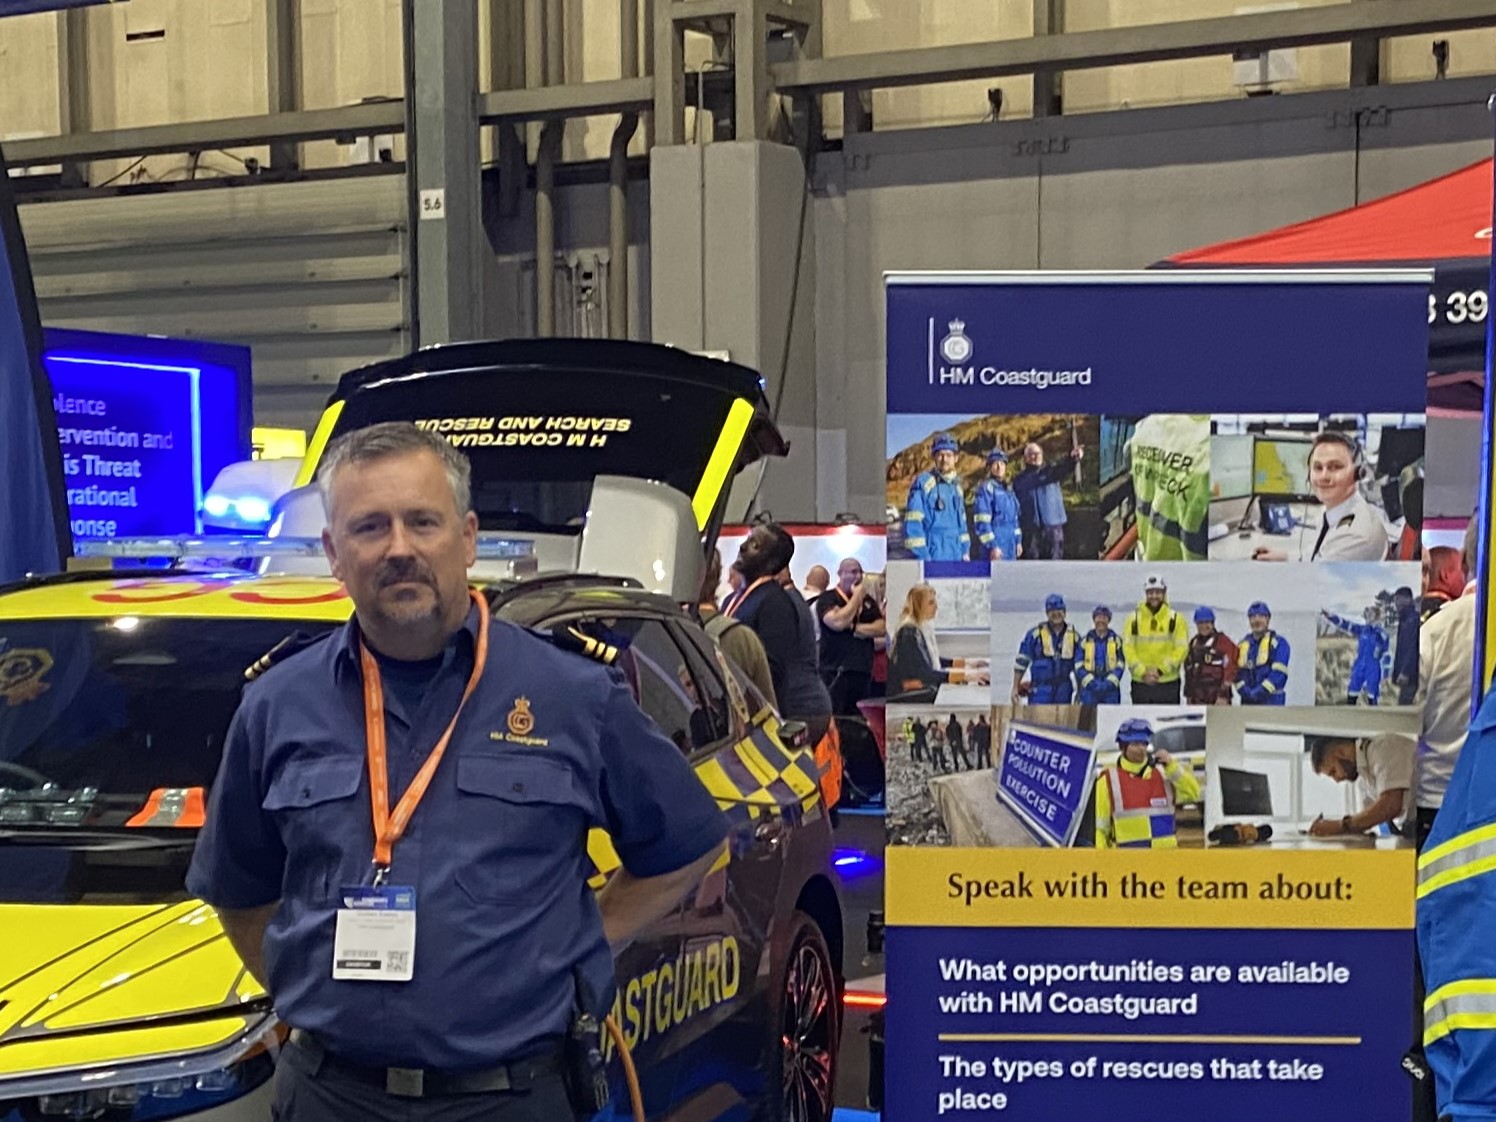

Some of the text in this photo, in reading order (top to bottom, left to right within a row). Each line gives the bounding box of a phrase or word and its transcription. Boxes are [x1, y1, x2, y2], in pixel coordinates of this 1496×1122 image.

[424, 197, 442, 211] 5.6
[939, 367, 1092, 389] HM Coastguard
[498, 417, 543, 430] AND
[546, 417, 632, 431] SEARCH
[58, 426, 173, 449] ervention and
[567, 433, 586, 446] M
[590, 434, 607, 447] H
[64, 453, 142, 478] is Threat
[67, 484, 138, 507] rational
[1013, 738, 1071, 774] COUNTER
[1008, 753, 1072, 799] POLLUTION
[1005, 774, 1058, 821] EXERCISE
[948, 870, 1352, 905] Speak with the team about:
[938, 959, 1350, 987] What opportunities are available
[600, 935, 740, 1064] ASTGUARD
[938, 992, 1198, 1019] with HM Coastguard
[938, 1056, 1324, 1083] The types of rescues that take
[938, 1089, 1008, 1114] place
